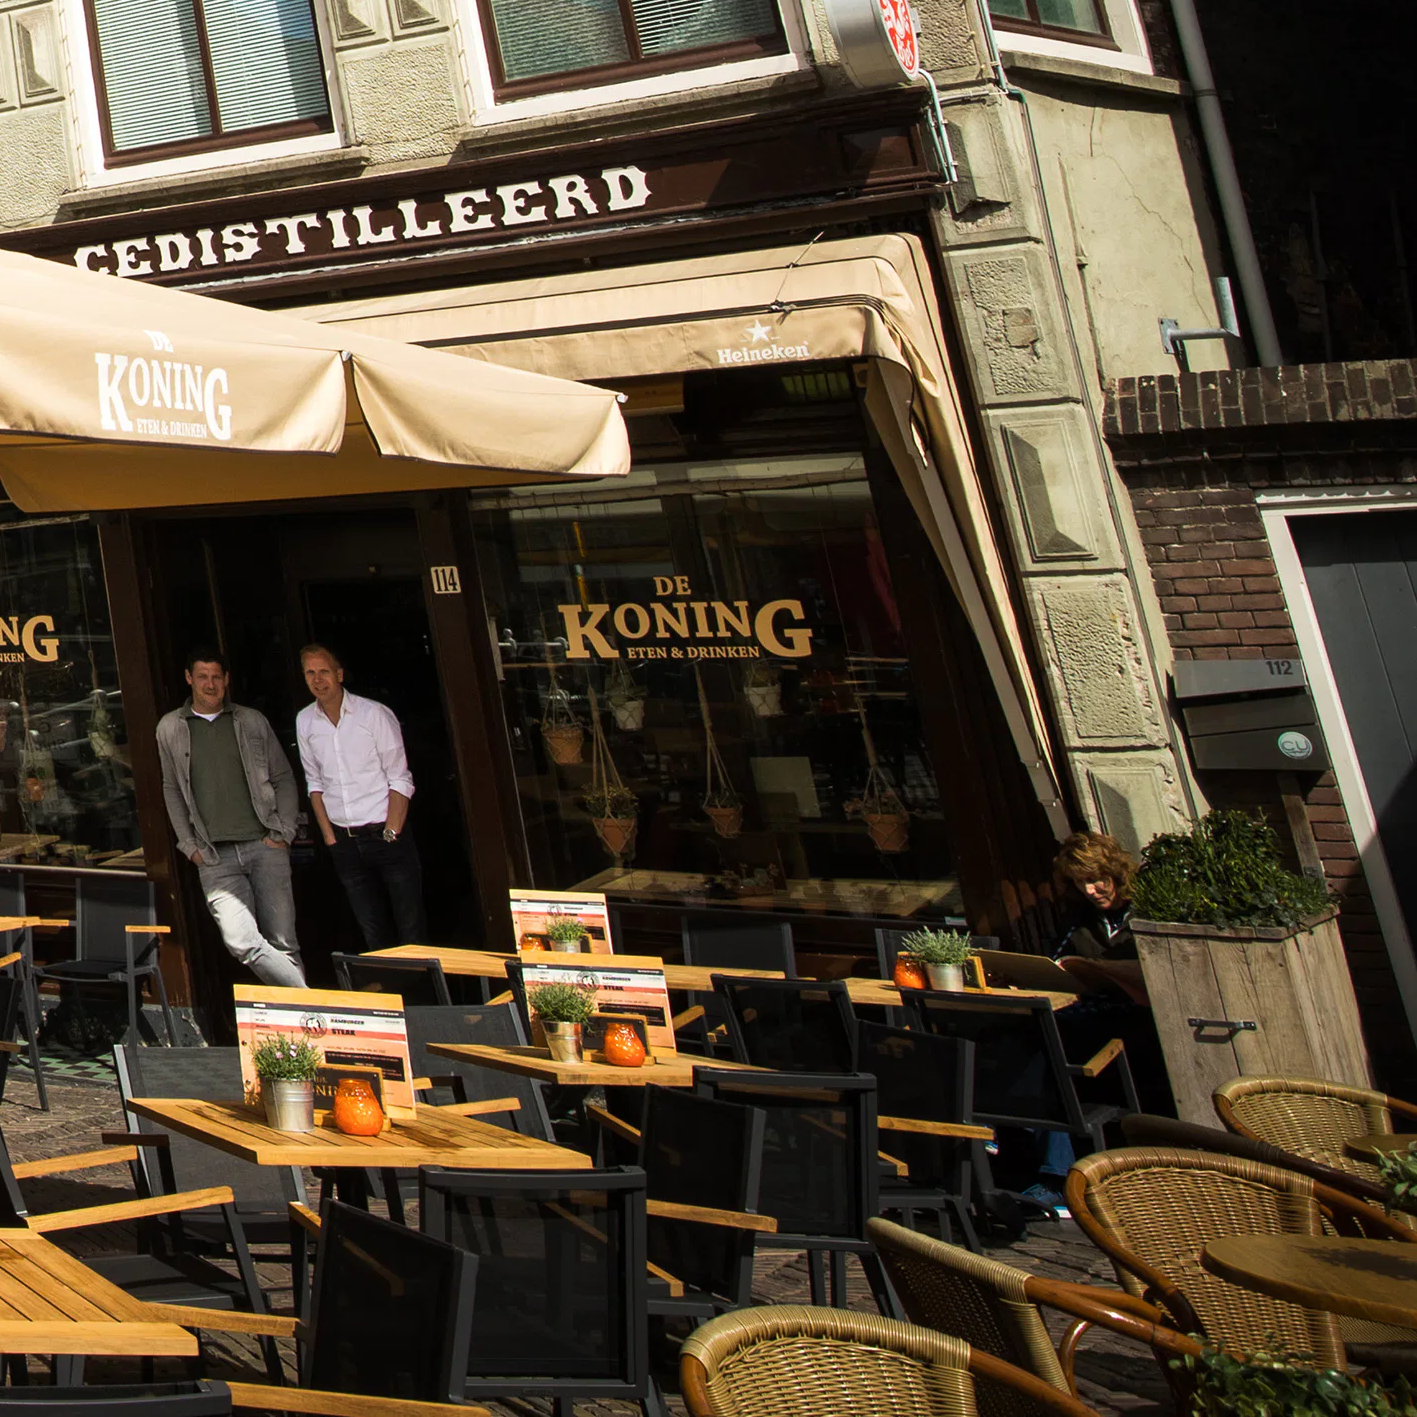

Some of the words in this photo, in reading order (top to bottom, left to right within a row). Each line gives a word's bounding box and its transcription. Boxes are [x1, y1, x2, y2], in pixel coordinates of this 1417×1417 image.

[143, 330, 173, 353] DE
[717, 343, 810, 364] Heineken
[95, 352, 232, 440] KONING
[137, 418, 160, 435] ETEN
[160, 420, 169, 435] &
[170, 420, 207, 438] DRINKEN
[434, 568, 458, 592] 114
[653, 575, 691, 596] DE
[557, 599, 813, 659] KONING
[627, 646, 666, 659] ETEN
[671, 646, 684, 659] &
[687, 645, 760, 659] DRINKEN
[1266, 660, 1293, 675] 112
